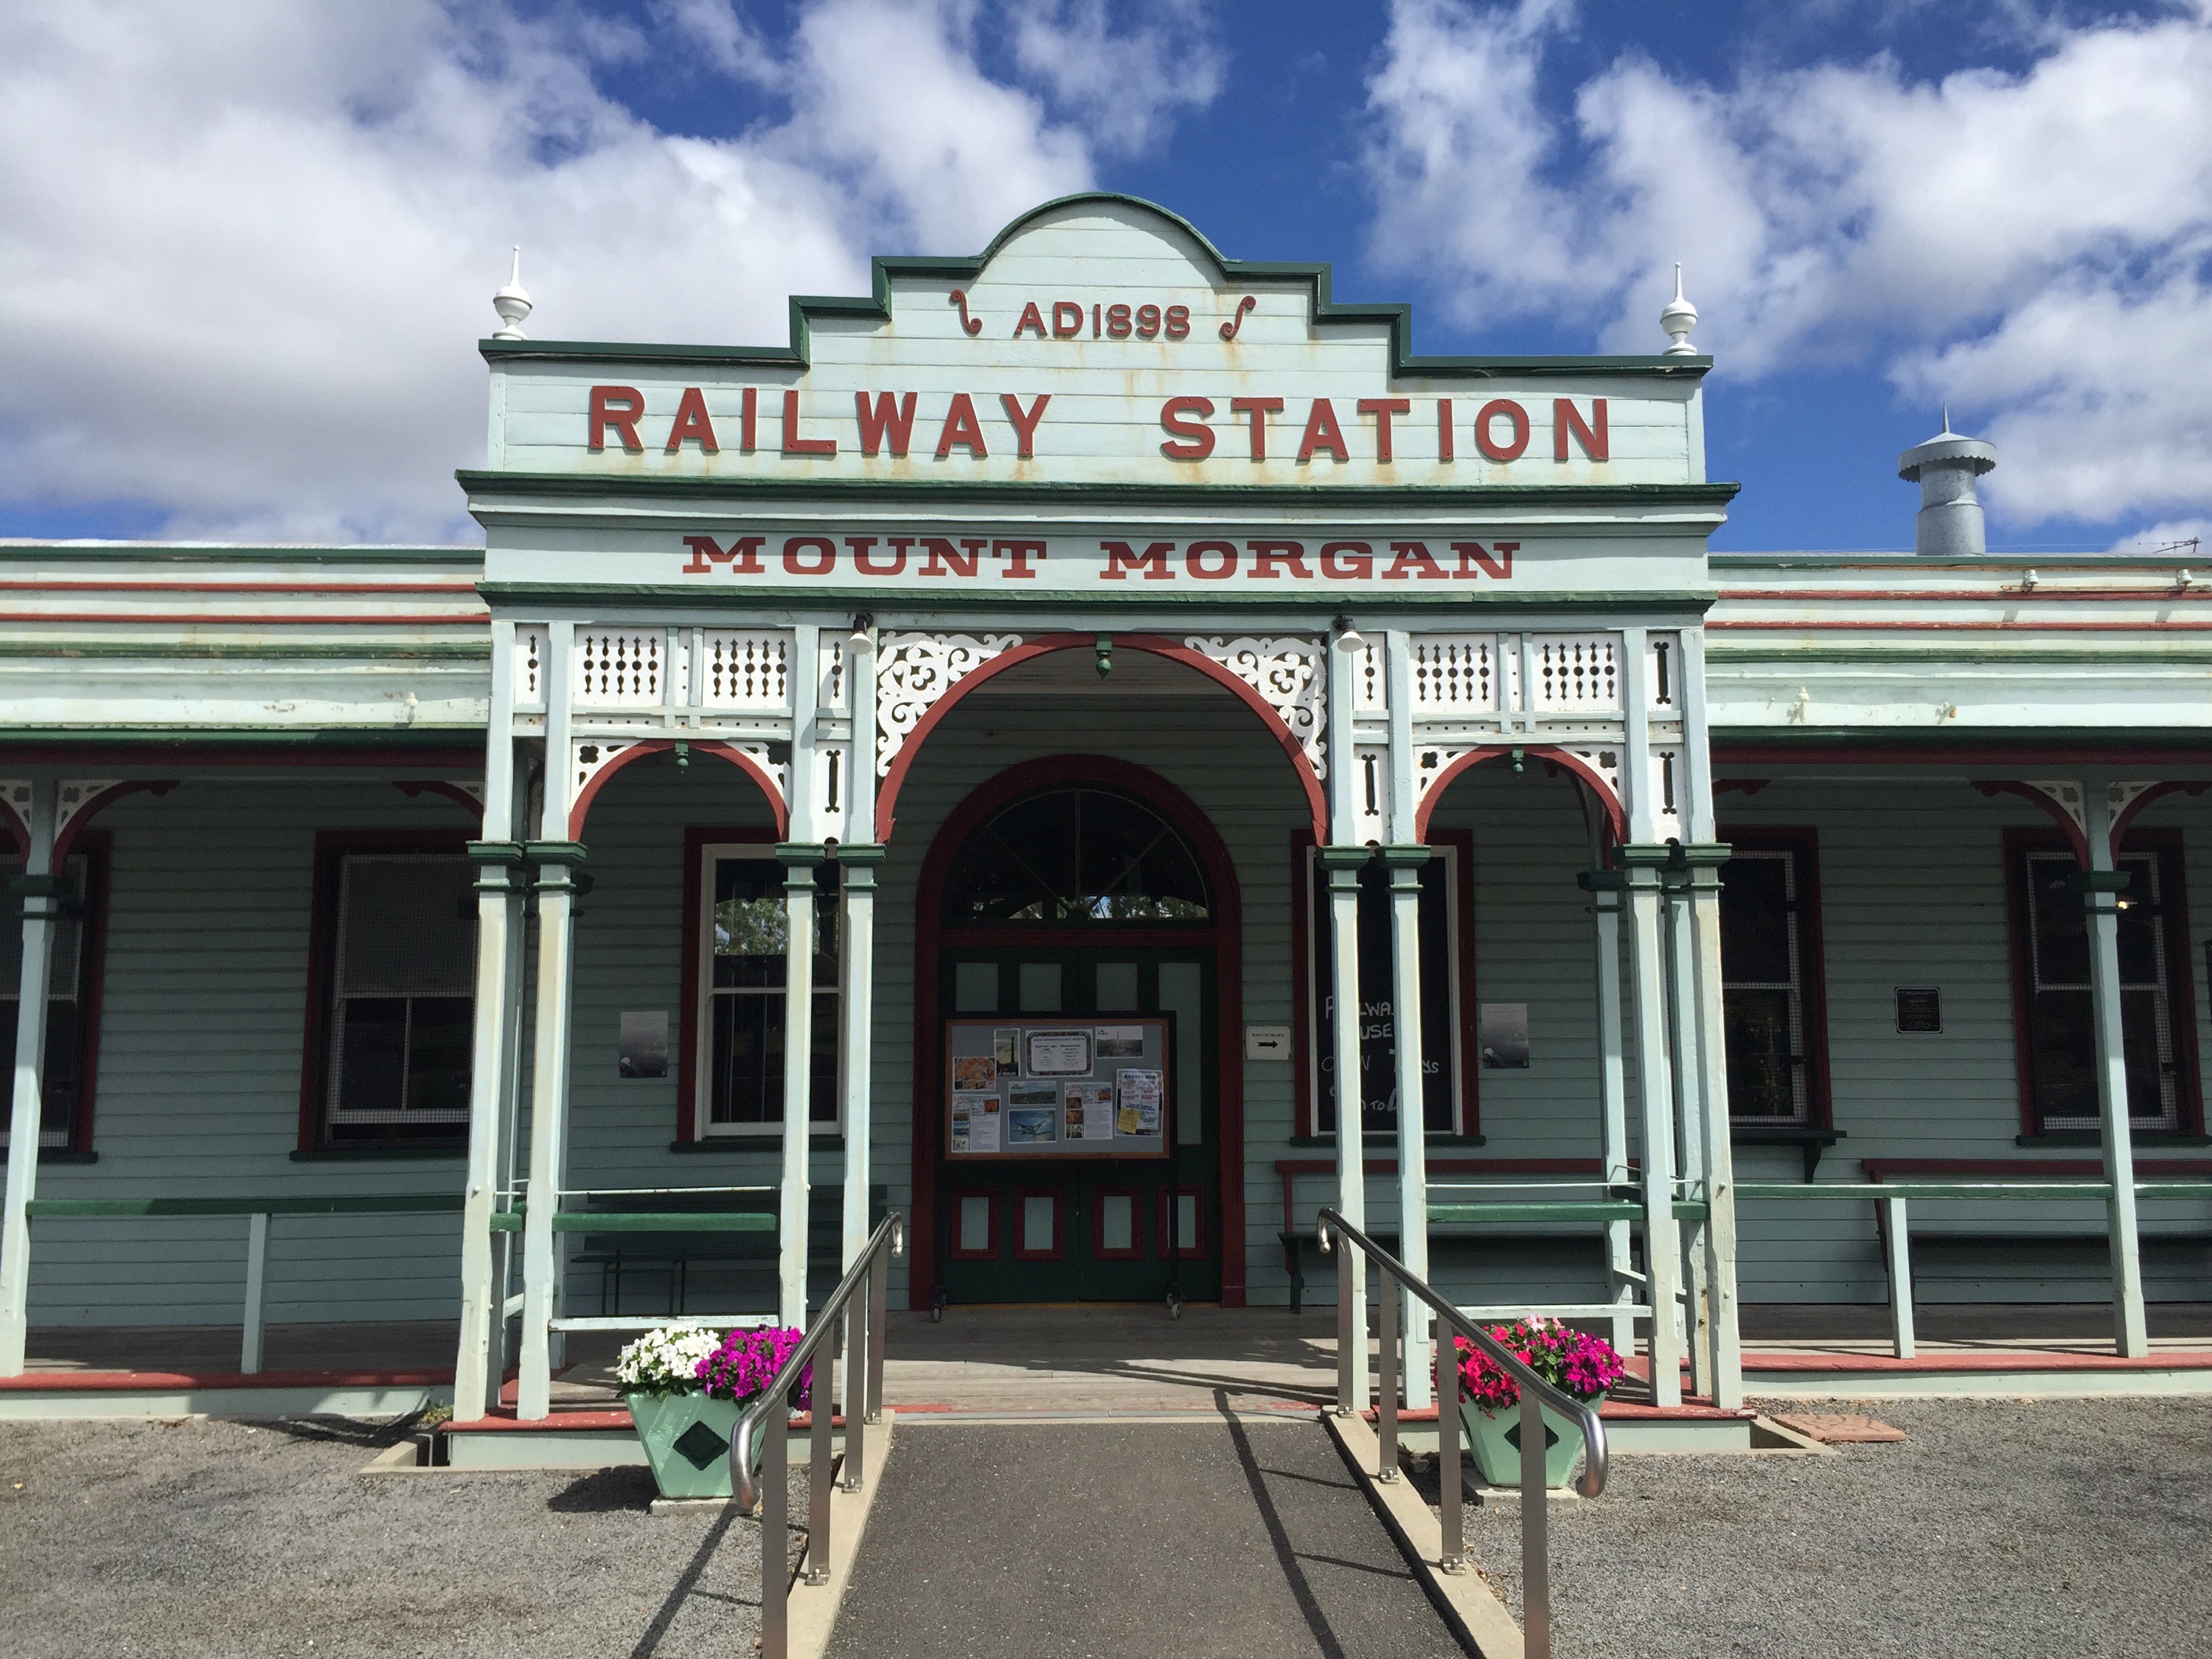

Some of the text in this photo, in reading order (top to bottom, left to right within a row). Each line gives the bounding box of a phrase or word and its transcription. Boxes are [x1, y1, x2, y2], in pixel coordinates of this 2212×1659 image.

[589, 386, 1609, 462] RAILWAY STATION
[683, 536, 1520, 580] MOUNT MORGAN
